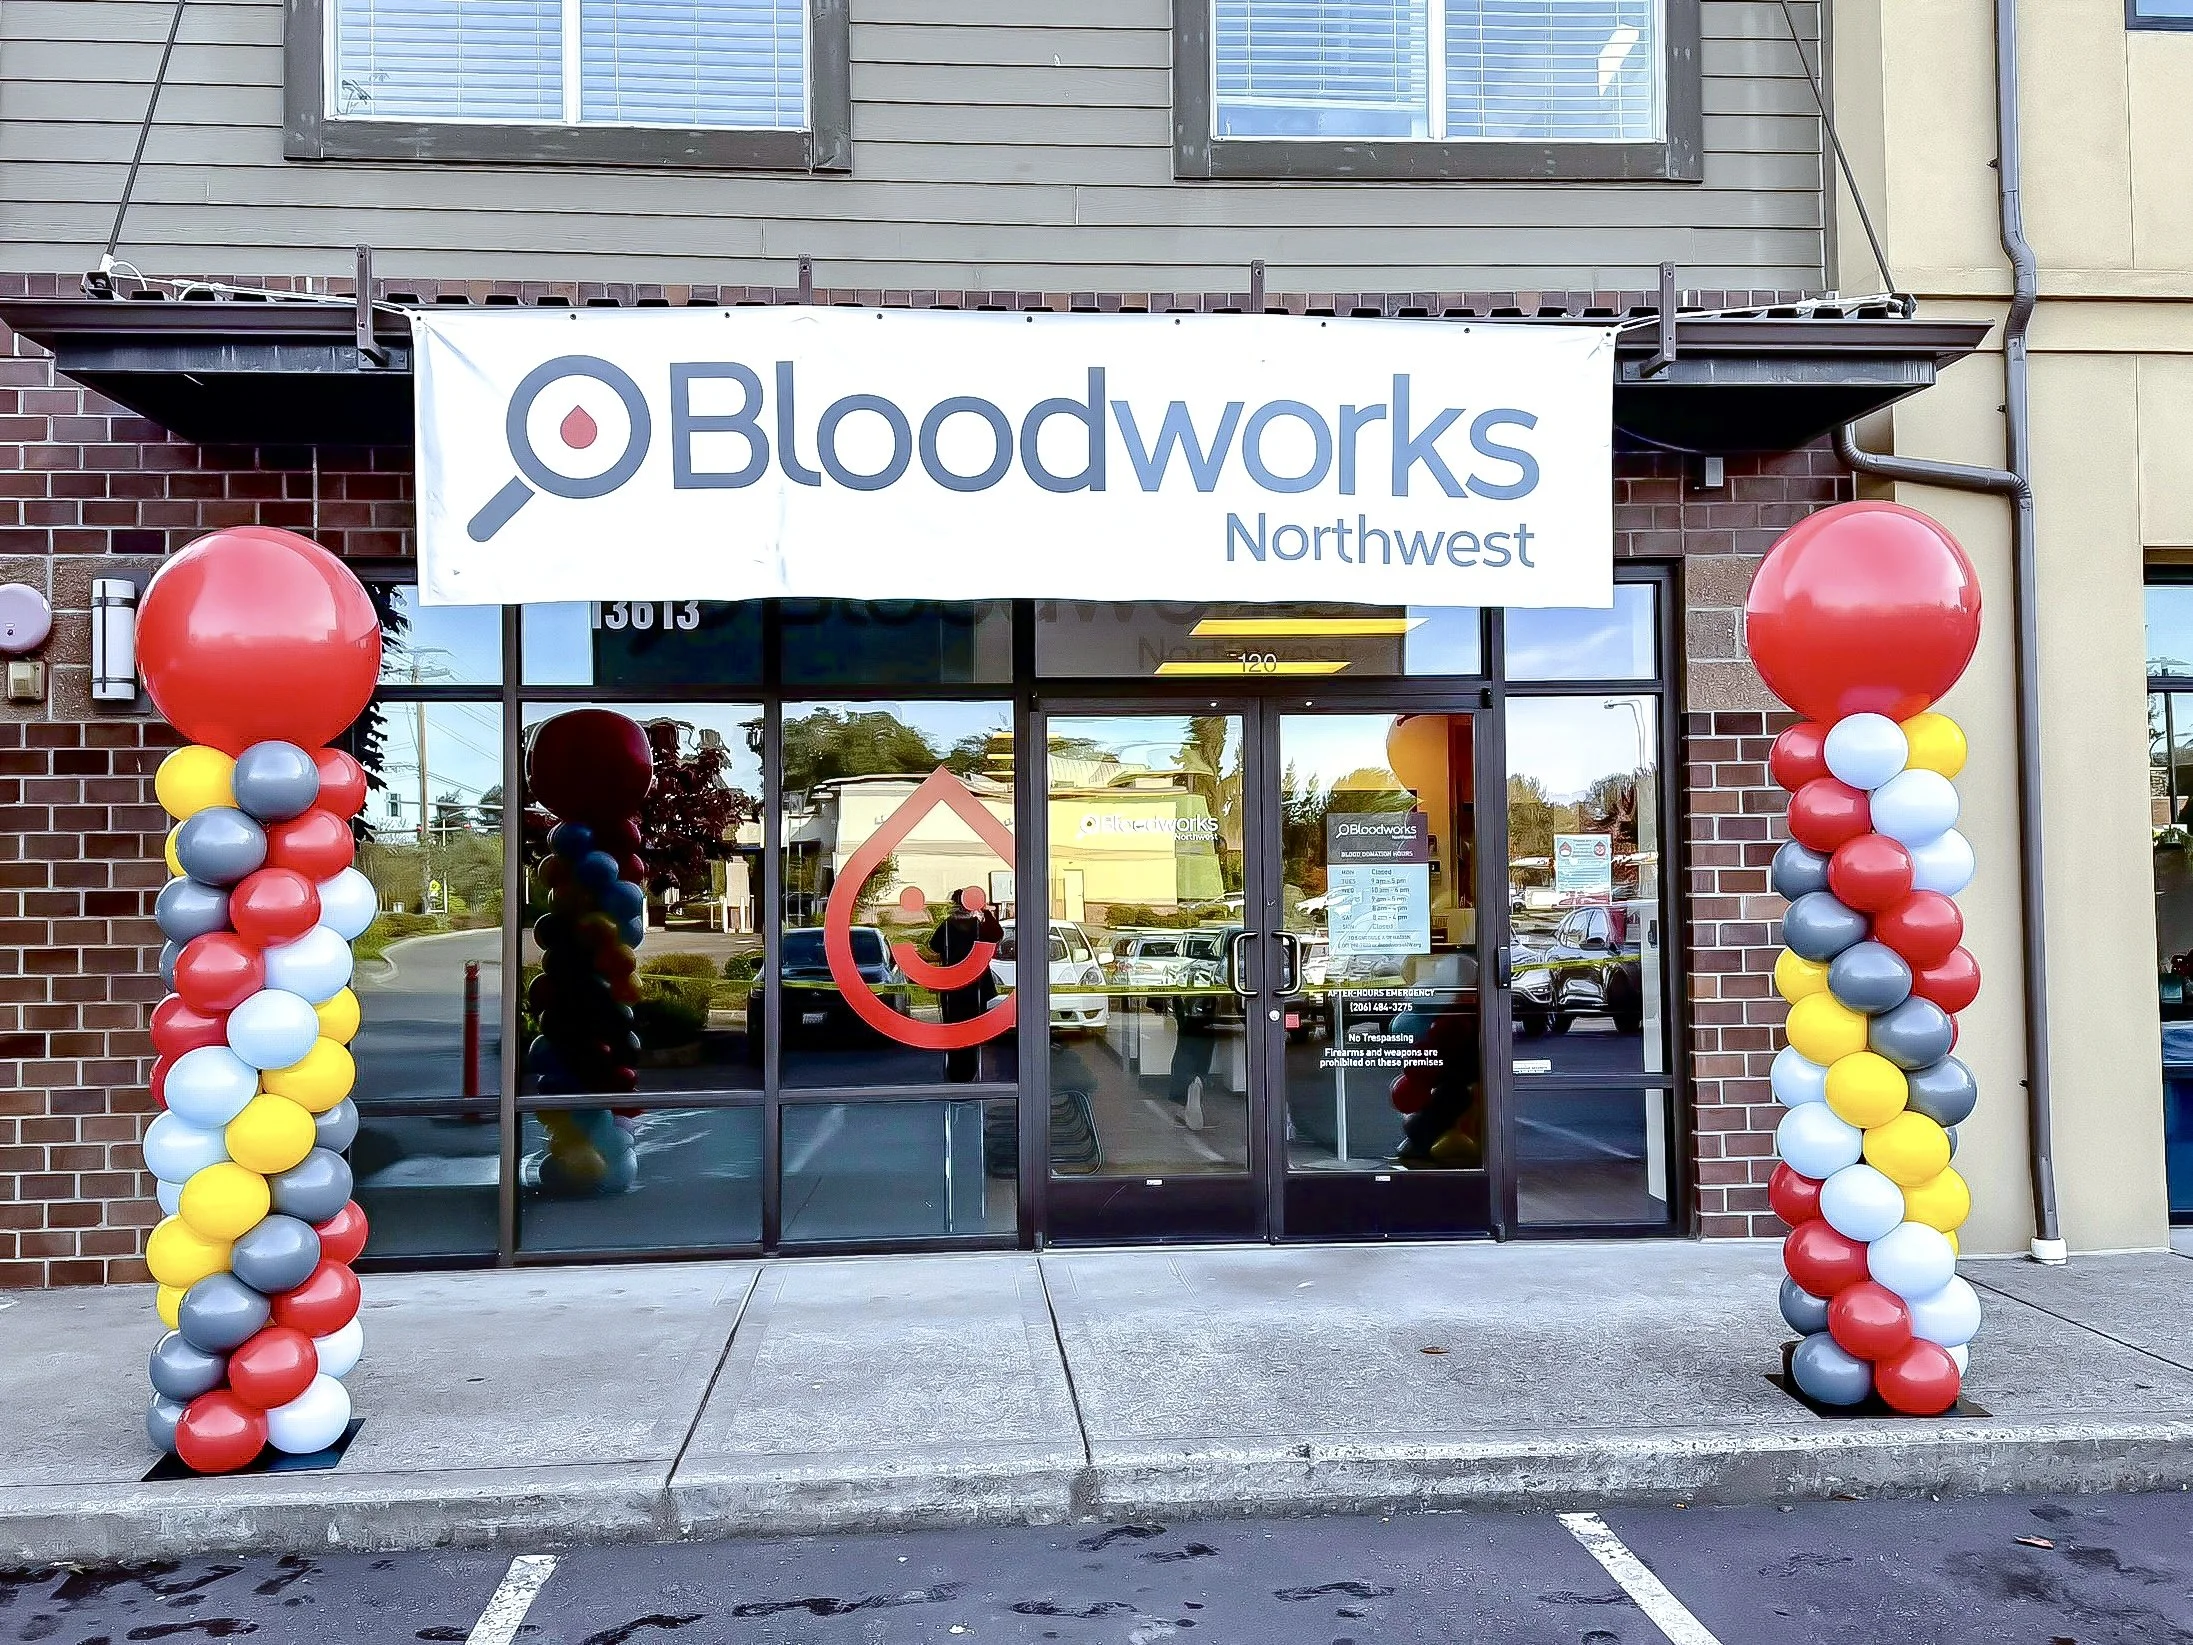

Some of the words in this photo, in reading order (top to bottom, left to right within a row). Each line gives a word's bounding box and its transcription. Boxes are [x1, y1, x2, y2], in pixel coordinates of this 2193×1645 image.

[670, 360, 1540, 500] Bloodworks
[1226, 512, 1536, 569] Northwest
[1240, 652, 1277, 673] 120
[1350, 822, 1417, 835] Bloodworks
[1173, 833, 1218, 841] Northwest
[1371, 868, 1392, 876] Closed
[1327, 989, 1385, 997] AFTER-HOURS
[1386, 989, 1436, 997] EMERGENCY
[1350, 1002, 1372, 1012] (206)
[1373, 1002, 1413, 1012] 484-3275
[1348, 1033, 1361, 1042] No
[1362, 1033, 1414, 1044] Trespassing
[1324, 1048, 1365, 1057] Firearms
[1366, 1048, 1382, 1057] and
[1384, 1049, 1422, 1058] weapons
[1424, 1049, 1438, 1057] are
[1319, 1058, 1364, 1069] prohibited
[1365, 1059, 1376, 1067] on
[1377, 1058, 1401, 1067] these
[1403, 1058, 1444, 1068] premises
